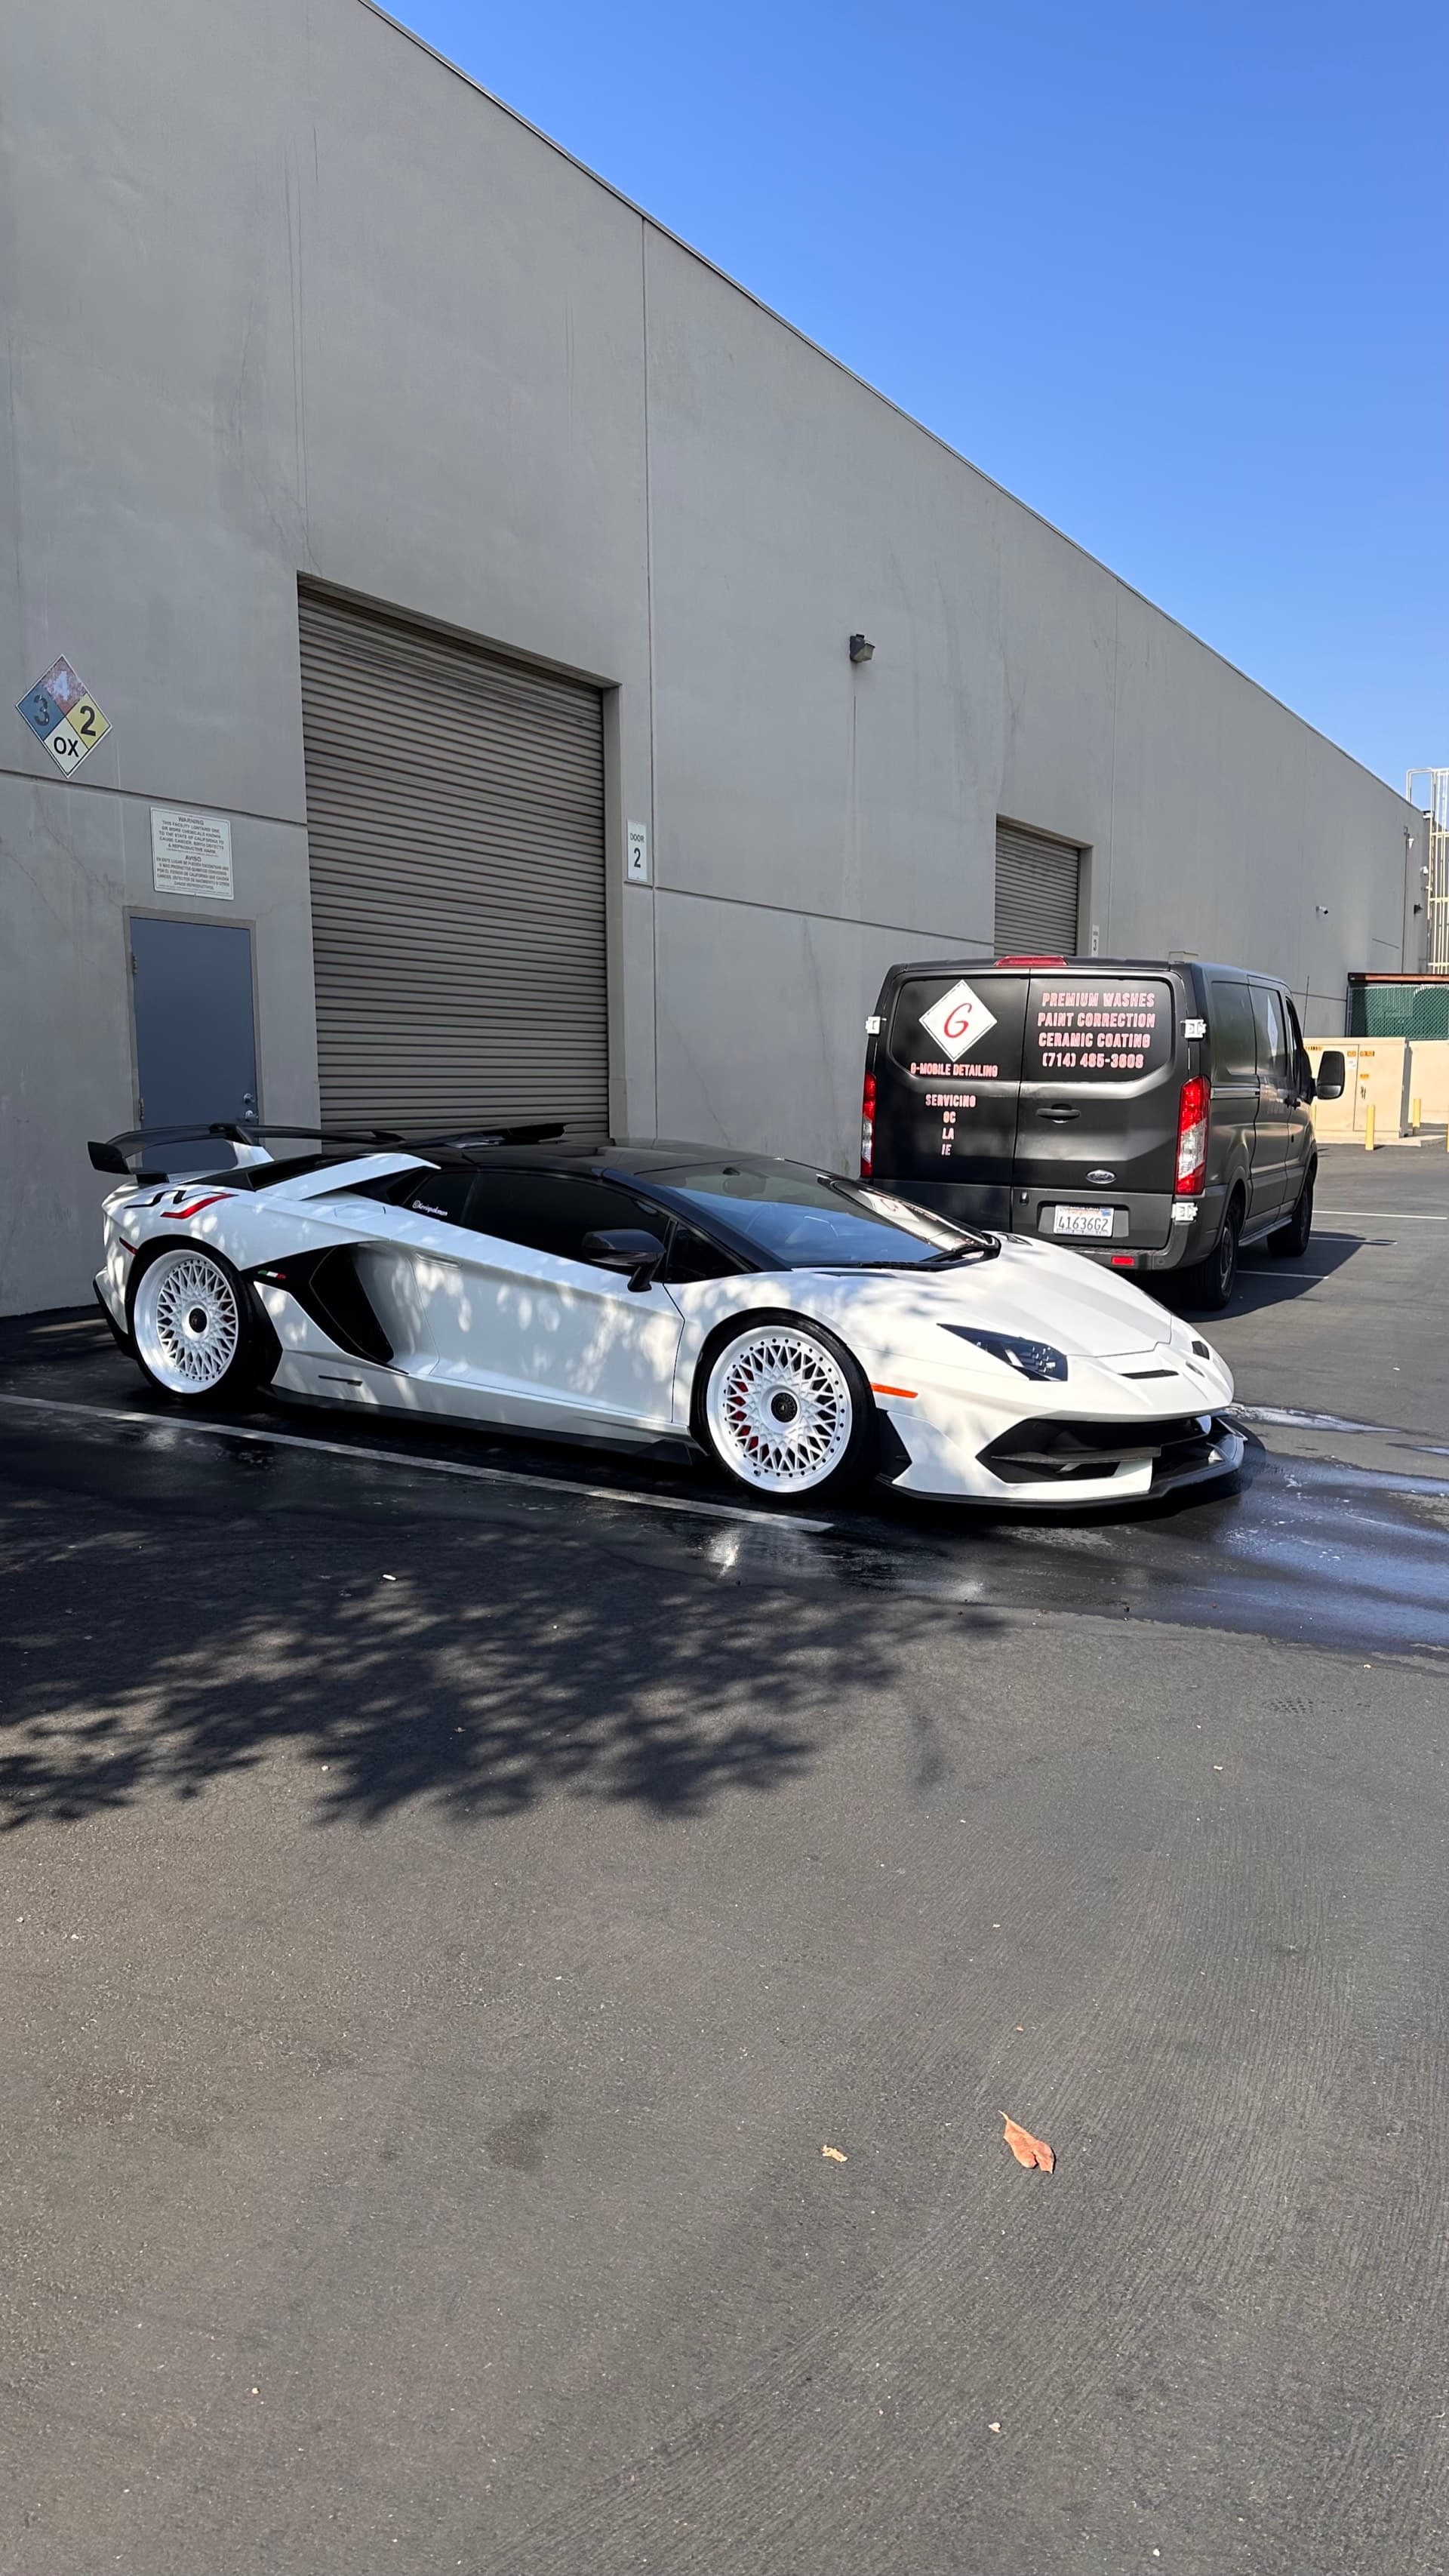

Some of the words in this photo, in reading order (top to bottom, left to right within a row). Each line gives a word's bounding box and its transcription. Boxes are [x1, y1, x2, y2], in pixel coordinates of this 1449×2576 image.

[33, 694, 50, 726] 3
[80, 705, 97, 737] 2
[54, 736, 79, 758] OX
[178, 817, 205, 826] WARNING
[630, 833, 645, 843] DOOR
[634, 848, 641, 868] 2
[1041, 993, 1099, 1007] PREMIUM
[1103, 993, 1155, 1008] WASHES
[943, 1002, 972, 1039] G
[1037, 1012, 1075, 1026] PAINT
[1077, 1013, 1155, 1028] CORRECTION
[1038, 1033, 1094, 1048] CERAMIC
[1097, 1033, 1151, 1048] COATING
[1042, 1052, 1076, 1067] (714)
[910, 1062, 951, 1076] G-MOBILE
[953, 1063, 998, 1077] DETAILING
[925, 1094, 977, 1108] SERVICING
[943, 1110, 956, 1124] OC
[942, 1127, 955, 1140] LA
[941, 1143, 952, 1156] IE
[1058, 1216, 1109, 1233] 41636G2
